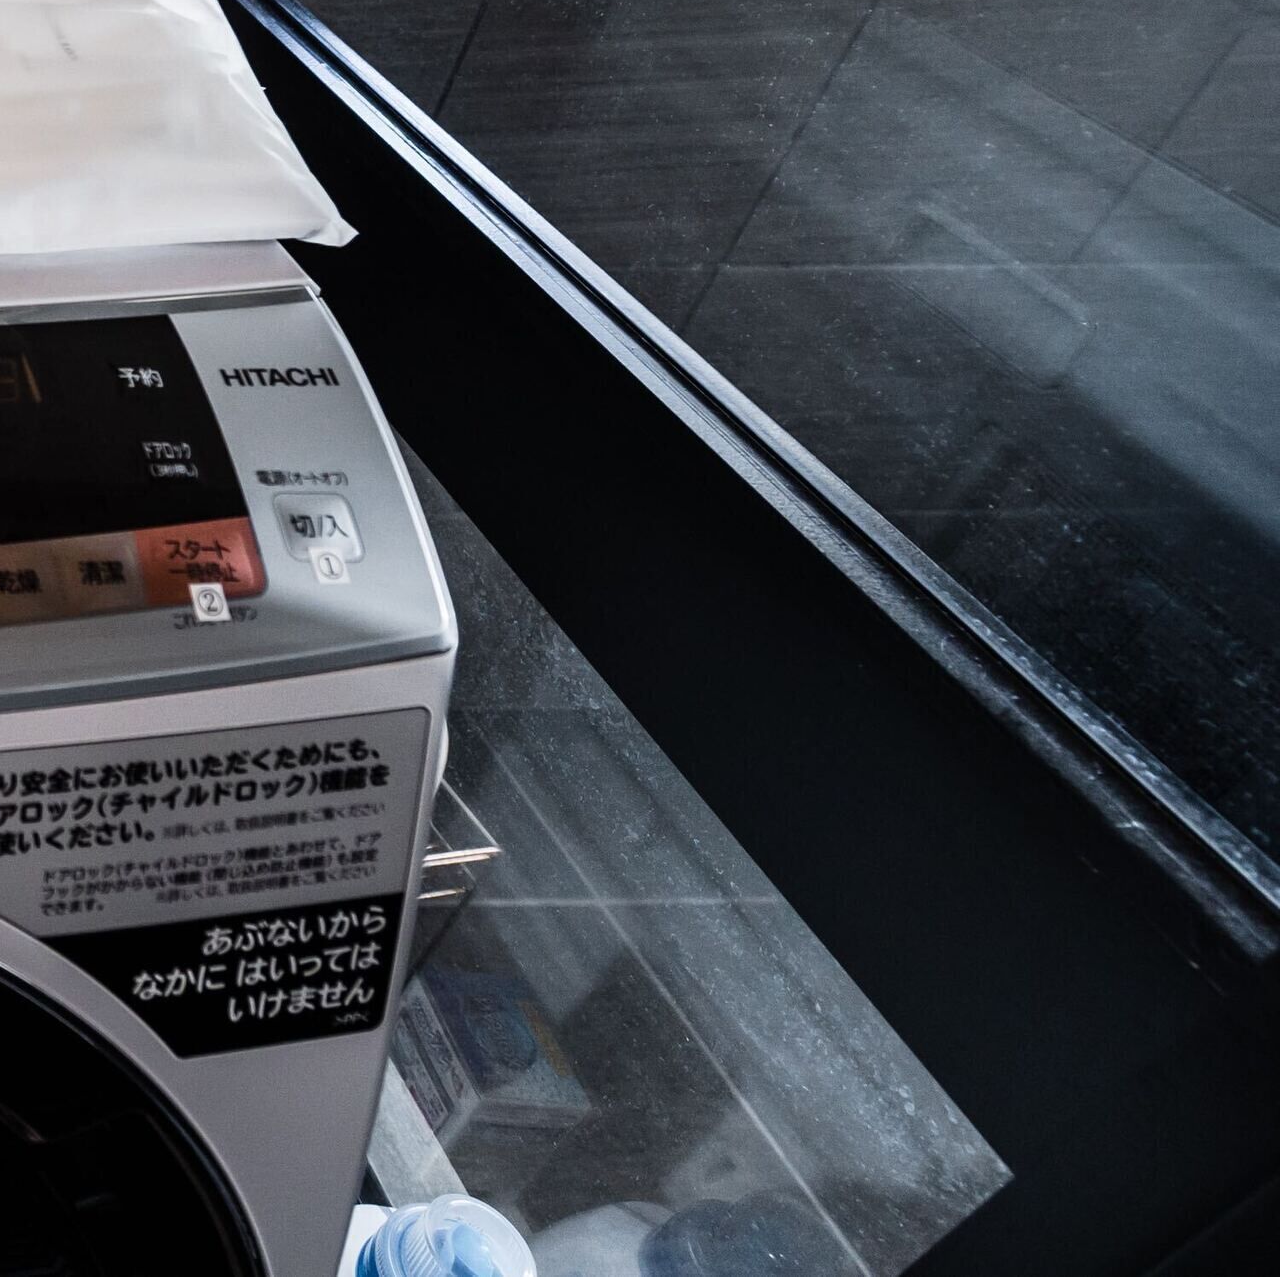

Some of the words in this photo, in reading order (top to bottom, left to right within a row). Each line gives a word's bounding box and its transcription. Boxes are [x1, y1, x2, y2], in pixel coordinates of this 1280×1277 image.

[118, 367, 164, 388] 予約
[219, 368, 340, 387] HITACHI
[291, 514, 349, 538] 切/入
[165, 539, 232, 559] スタート
[202, 906, 386, 956] あぶないから
[133, 965, 227, 1000] なかに
[236, 942, 382, 987] はいっては
[228, 978, 374, 1022] いけません
